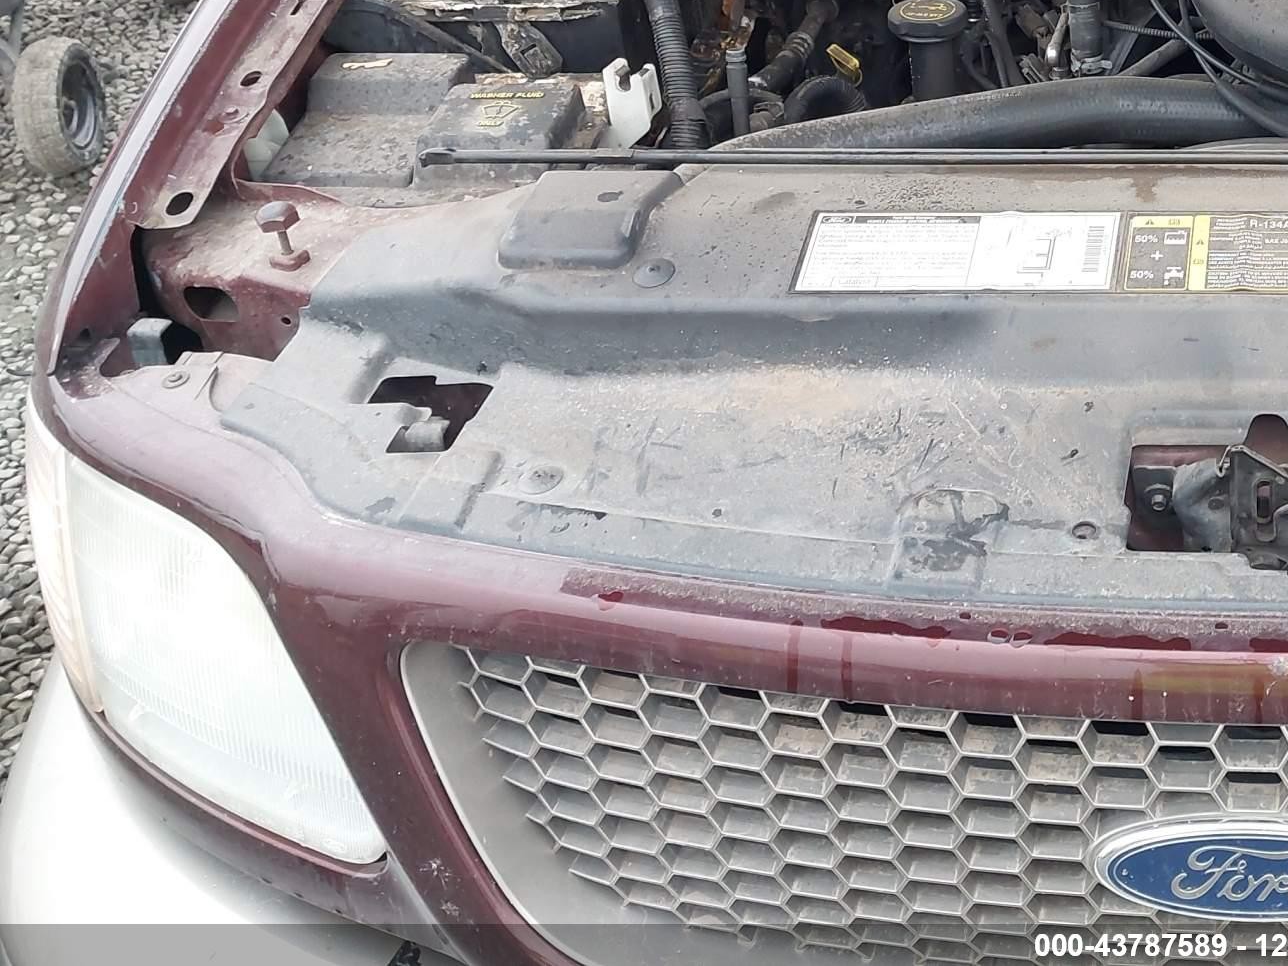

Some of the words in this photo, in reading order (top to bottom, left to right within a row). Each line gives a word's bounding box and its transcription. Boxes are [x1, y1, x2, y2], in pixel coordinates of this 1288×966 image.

[515, 91, 545, 99] FLUID
[1134, 234, 1159, 243] 50%
[1130, 270, 1154, 279] 50%
